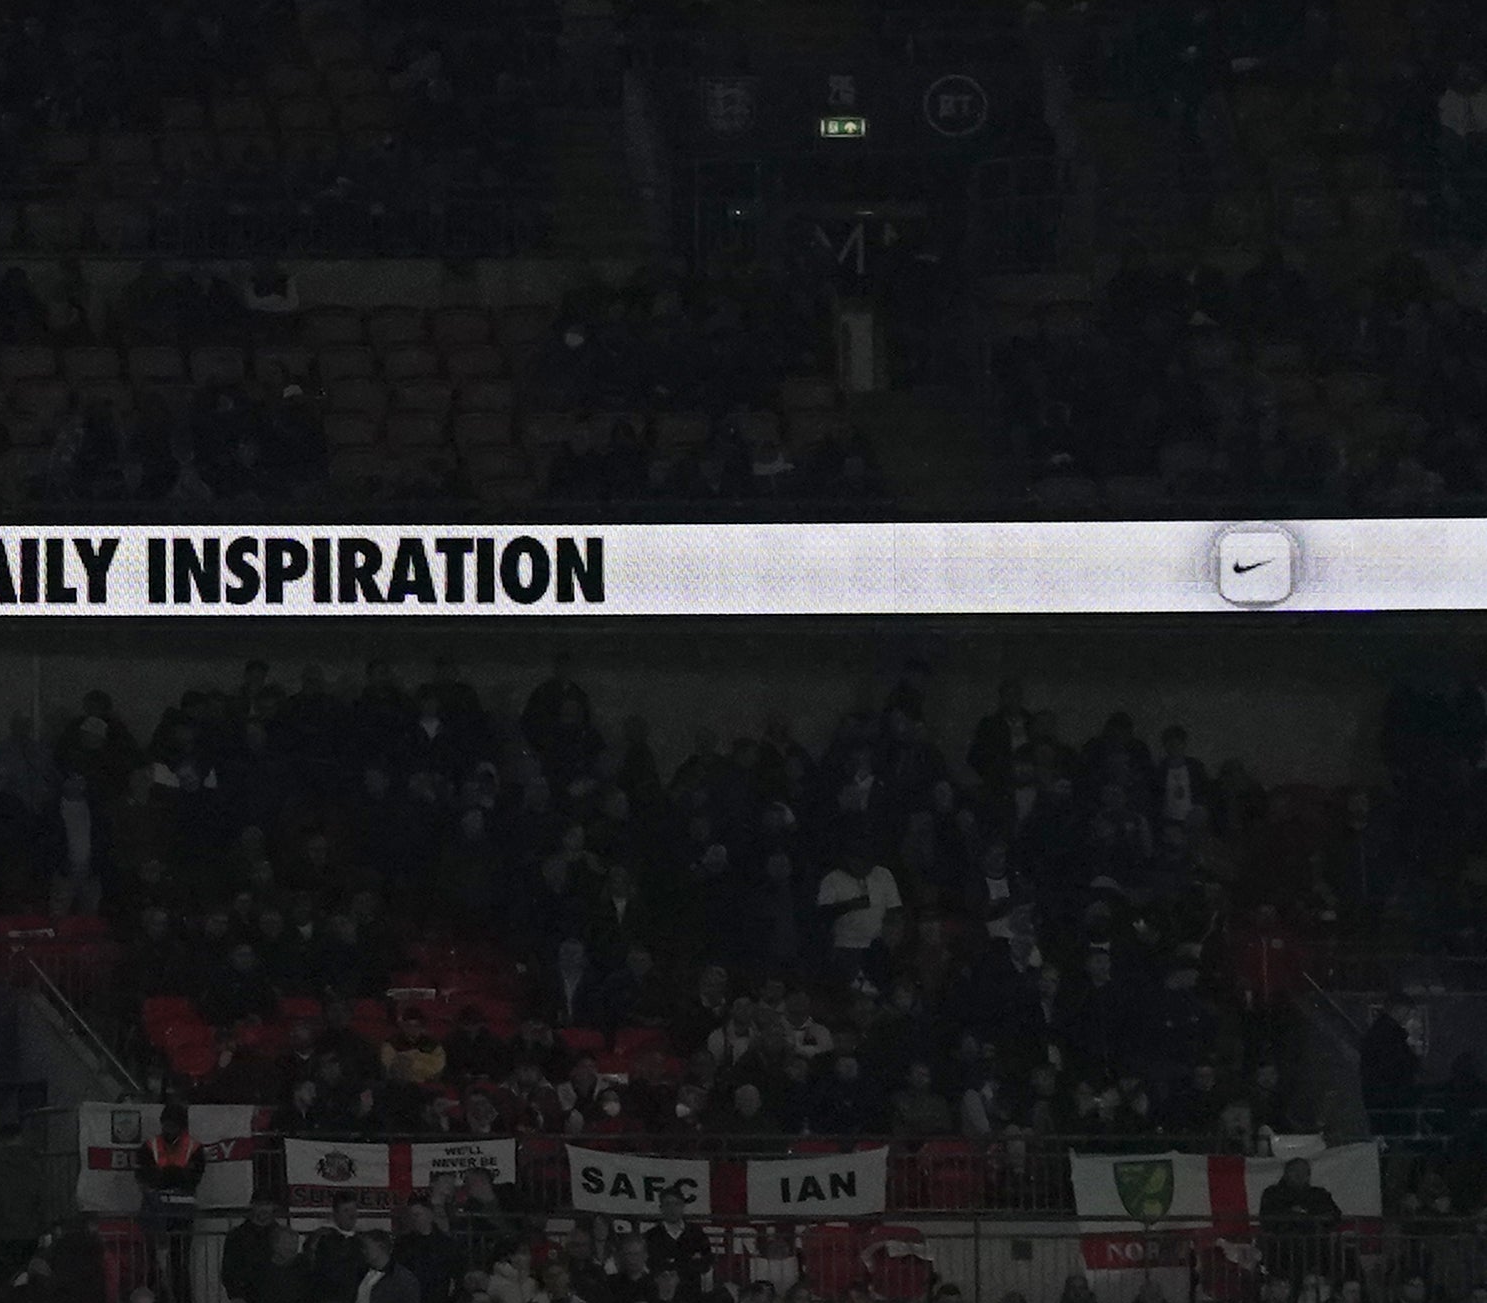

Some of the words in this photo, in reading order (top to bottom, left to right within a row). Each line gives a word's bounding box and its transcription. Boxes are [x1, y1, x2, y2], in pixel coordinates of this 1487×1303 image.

[938, 94, 973, 116] BT
[148, 536, 604, 606] INSPIRATION
[431, 1157, 477, 1168] NEVER
[480, 1156, 498, 1166] BE
[581, 1166, 699, 1204] SAFC
[780, 1171, 857, 1204] IAN
